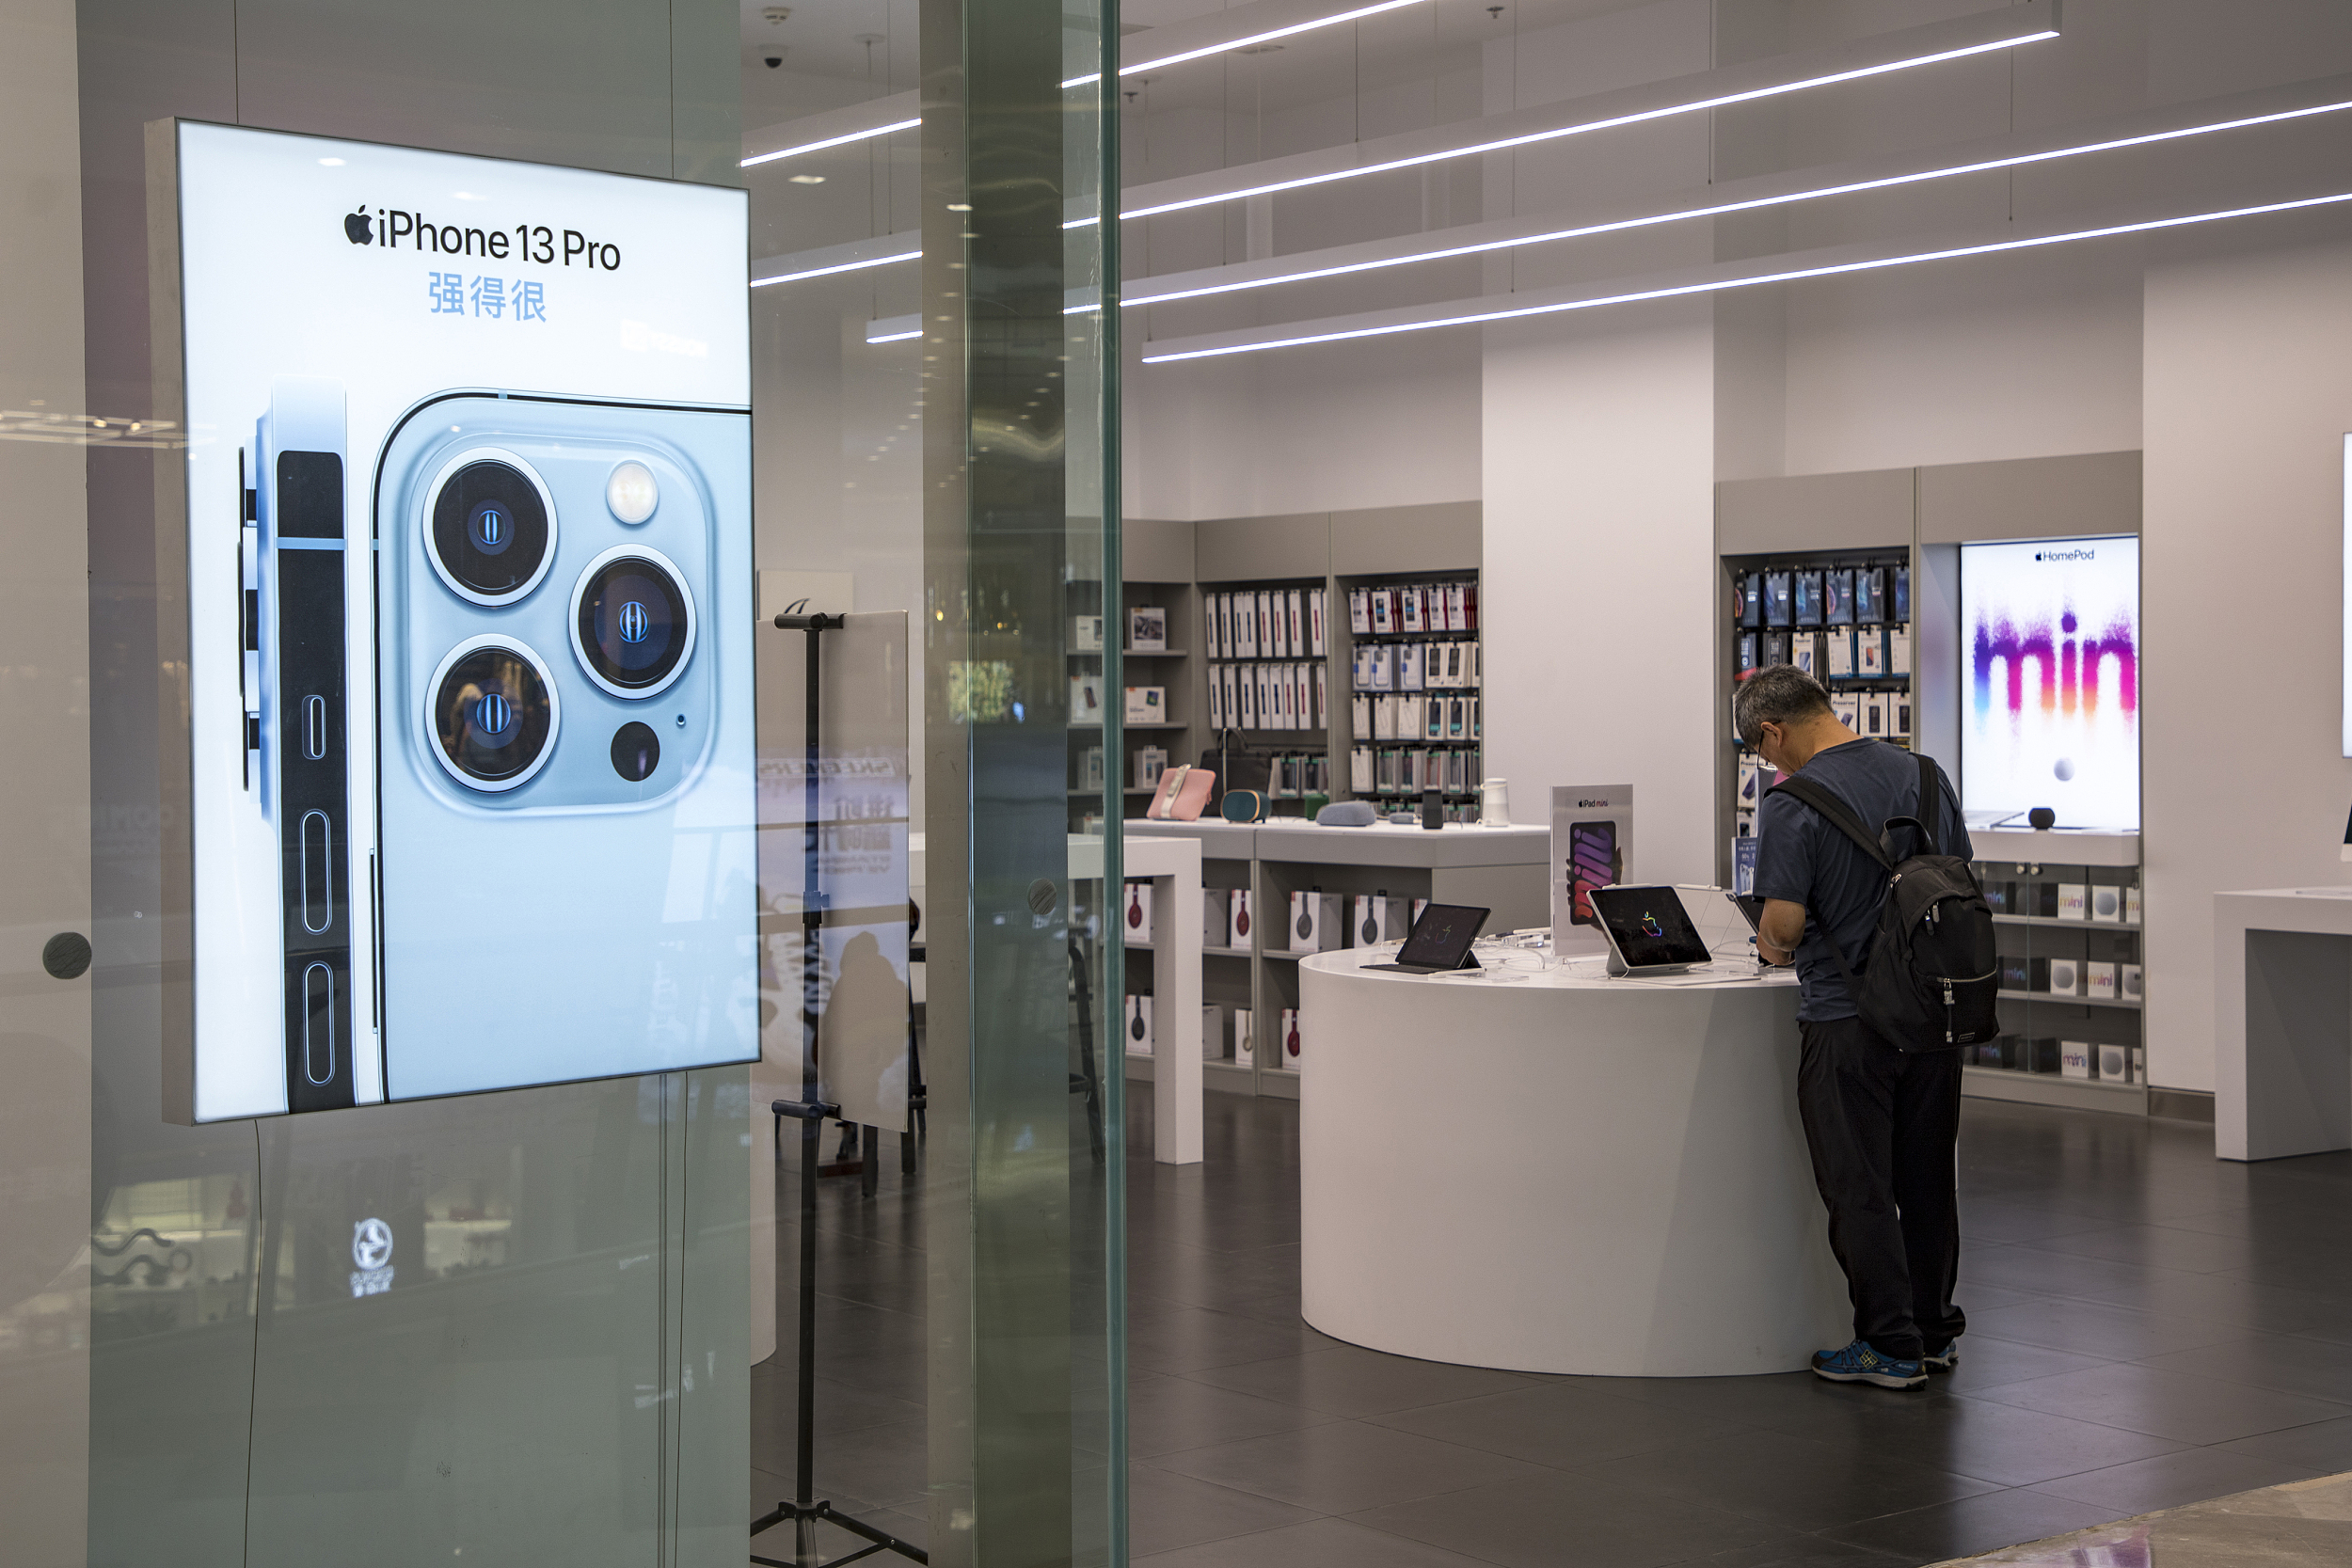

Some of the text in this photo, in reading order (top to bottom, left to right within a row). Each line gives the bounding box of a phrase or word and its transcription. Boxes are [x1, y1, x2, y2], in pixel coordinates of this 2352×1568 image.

[378, 208, 621, 271] iPhone 13 Pro
[428, 271, 548, 324] 强得很
[2042, 548, 2095, 562] HomePod
[1972, 608, 2137, 720] mini
[1582, 798, 1609, 808] iPad mini
[2058, 895, 2083, 909] mini
[2090, 973, 2113, 988] mini
[2062, 1052, 2088, 1069] mini
